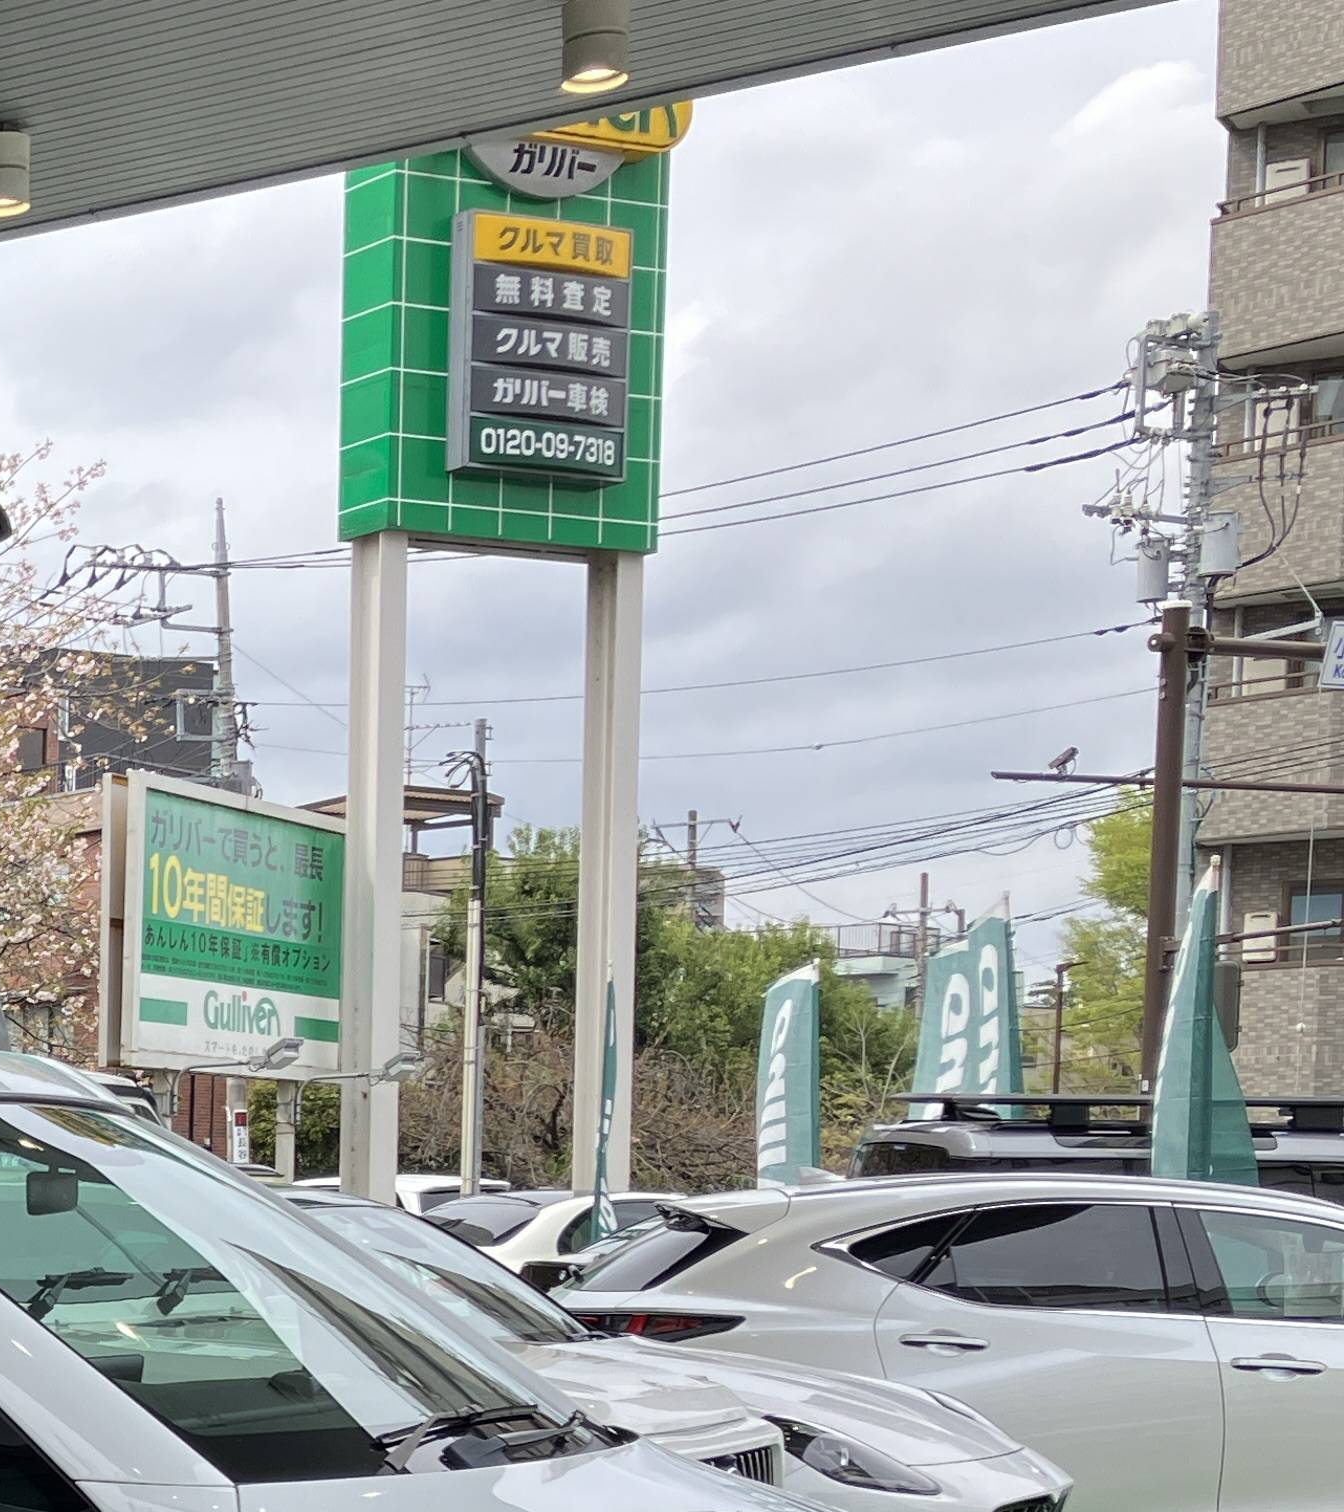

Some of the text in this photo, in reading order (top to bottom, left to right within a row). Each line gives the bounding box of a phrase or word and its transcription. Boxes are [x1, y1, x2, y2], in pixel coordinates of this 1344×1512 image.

[508, 142, 597, 181] ガリバー
[498, 225, 615, 266] クルマ買取
[494, 273, 612, 317] 無料査定
[495, 328, 611, 367] クルマ販売
[492, 379, 609, 417] ガリバー車検
[480, 427, 615, 466] 0120-09-7318
[203, 990, 281, 1037] Gulliver
